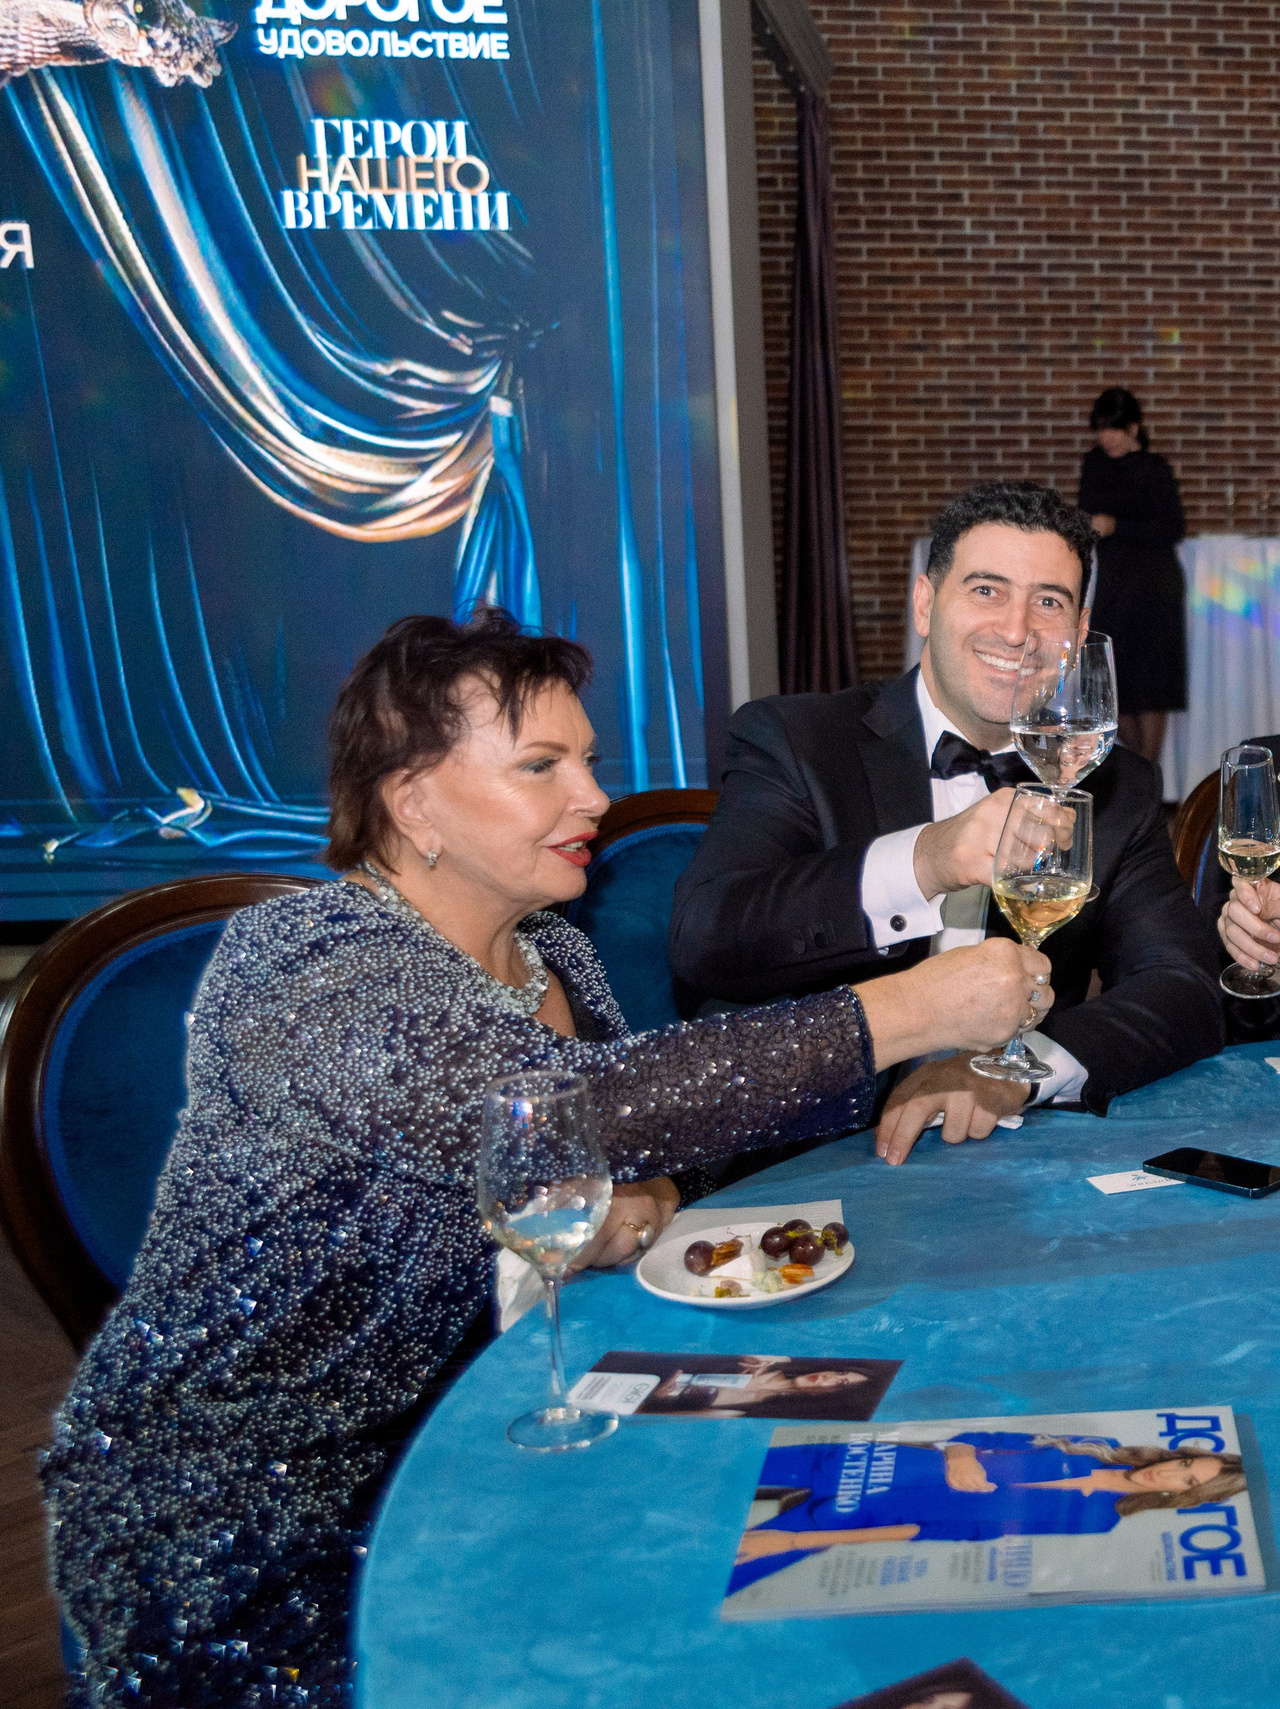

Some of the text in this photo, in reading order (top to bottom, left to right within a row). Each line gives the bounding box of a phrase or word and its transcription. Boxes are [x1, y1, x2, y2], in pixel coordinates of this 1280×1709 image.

[257, 27, 510, 60] УДОВОЛЬСТВИЕ
[311, 117, 469, 160] ГЕРОИ
[296, 152, 490, 195] НАШЕГО
[280, 189, 512, 231] ВРЕМЕНИ
[1156, 1413, 1248, 1581] ДОГОЕ
